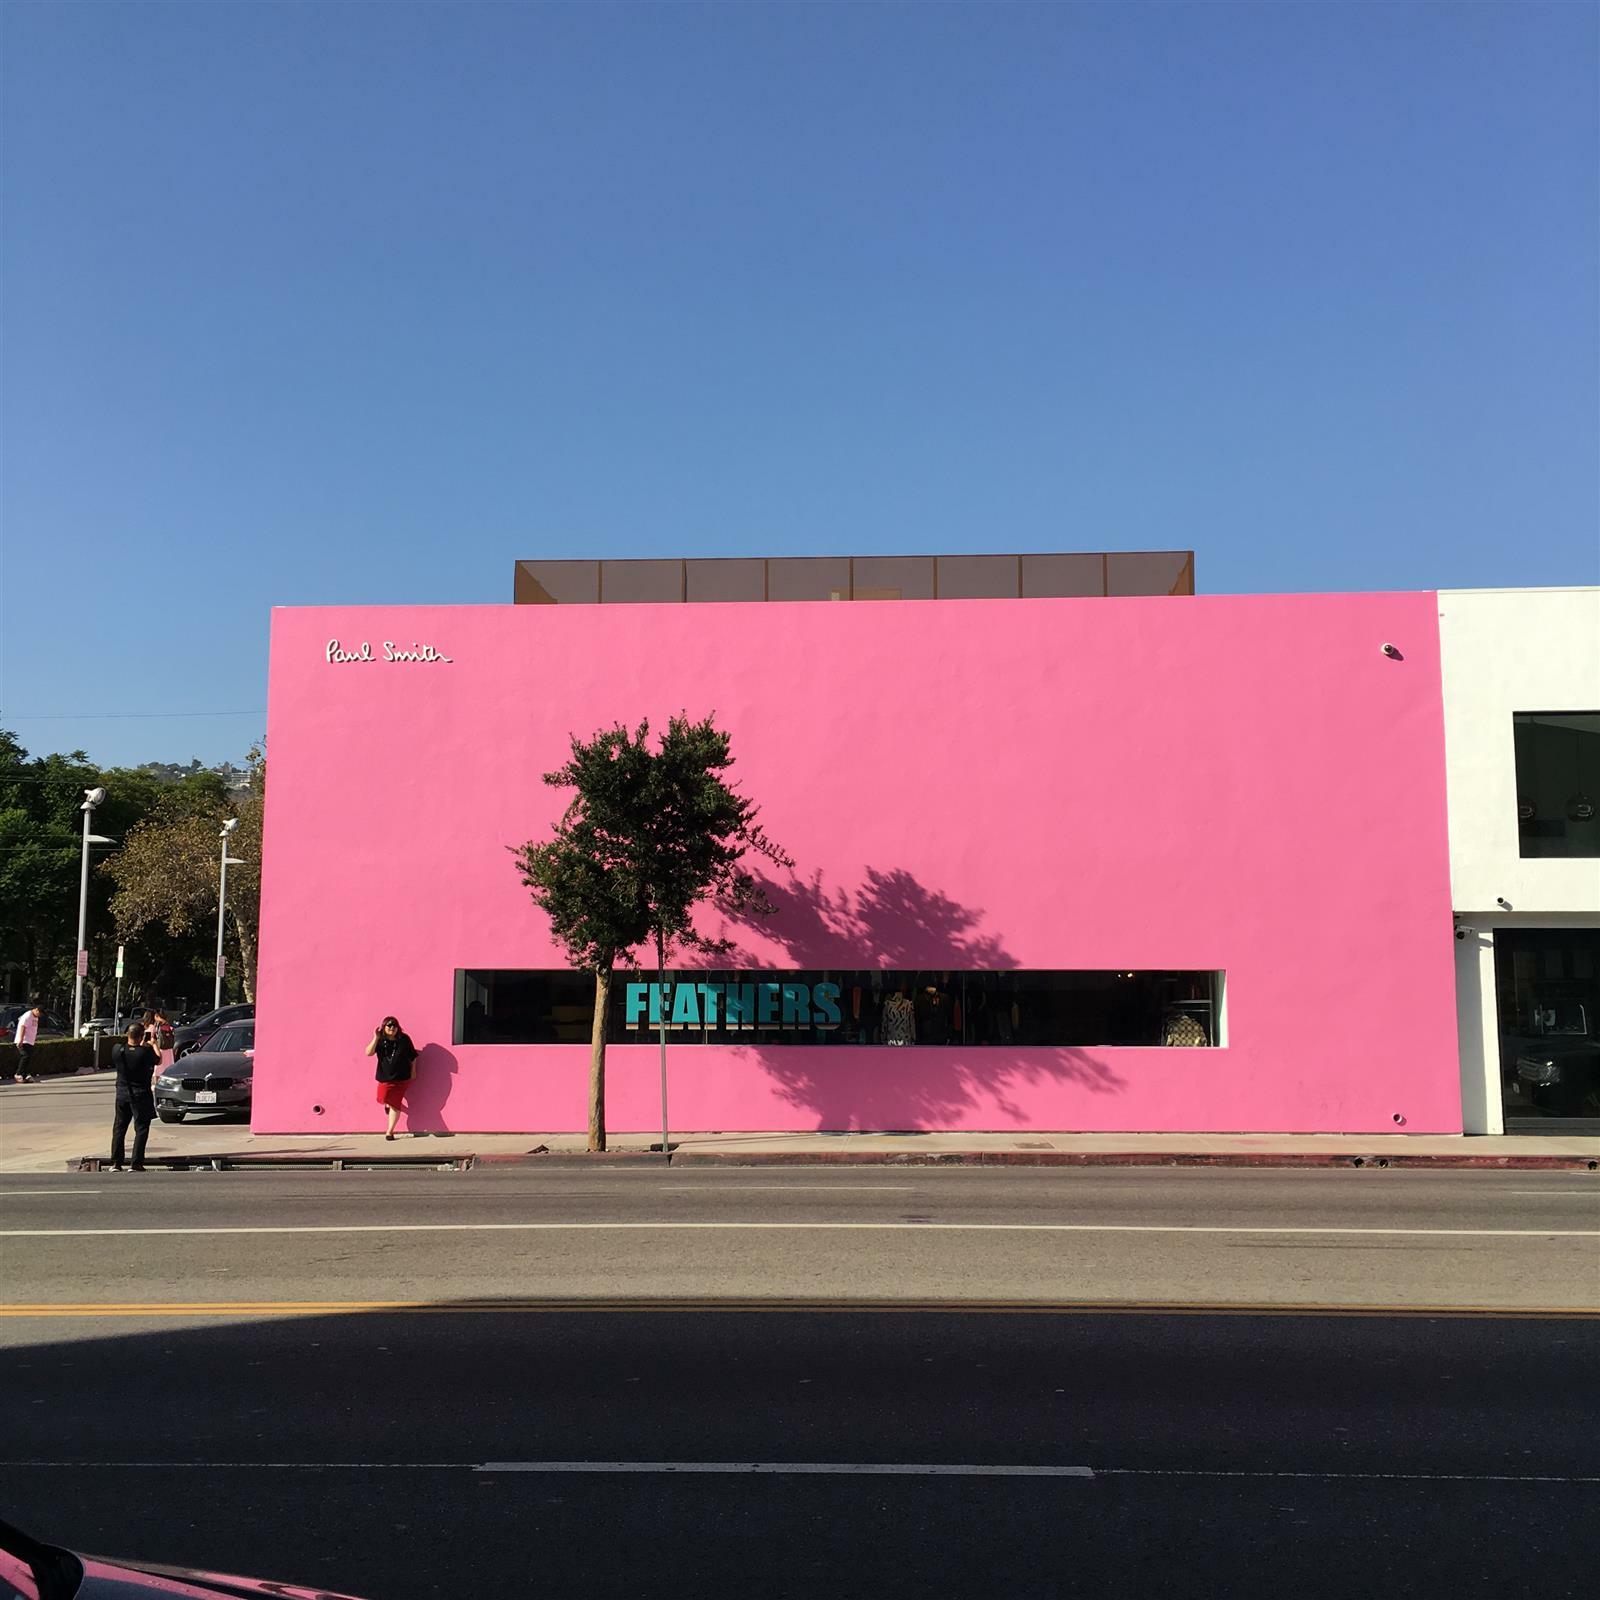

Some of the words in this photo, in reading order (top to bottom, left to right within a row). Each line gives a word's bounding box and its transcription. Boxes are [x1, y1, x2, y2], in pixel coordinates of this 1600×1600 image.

[326, 639, 375, 663] Paul
[383, 641, 452, 663] Smith
[626, 982, 842, 1030] FEATHERS
